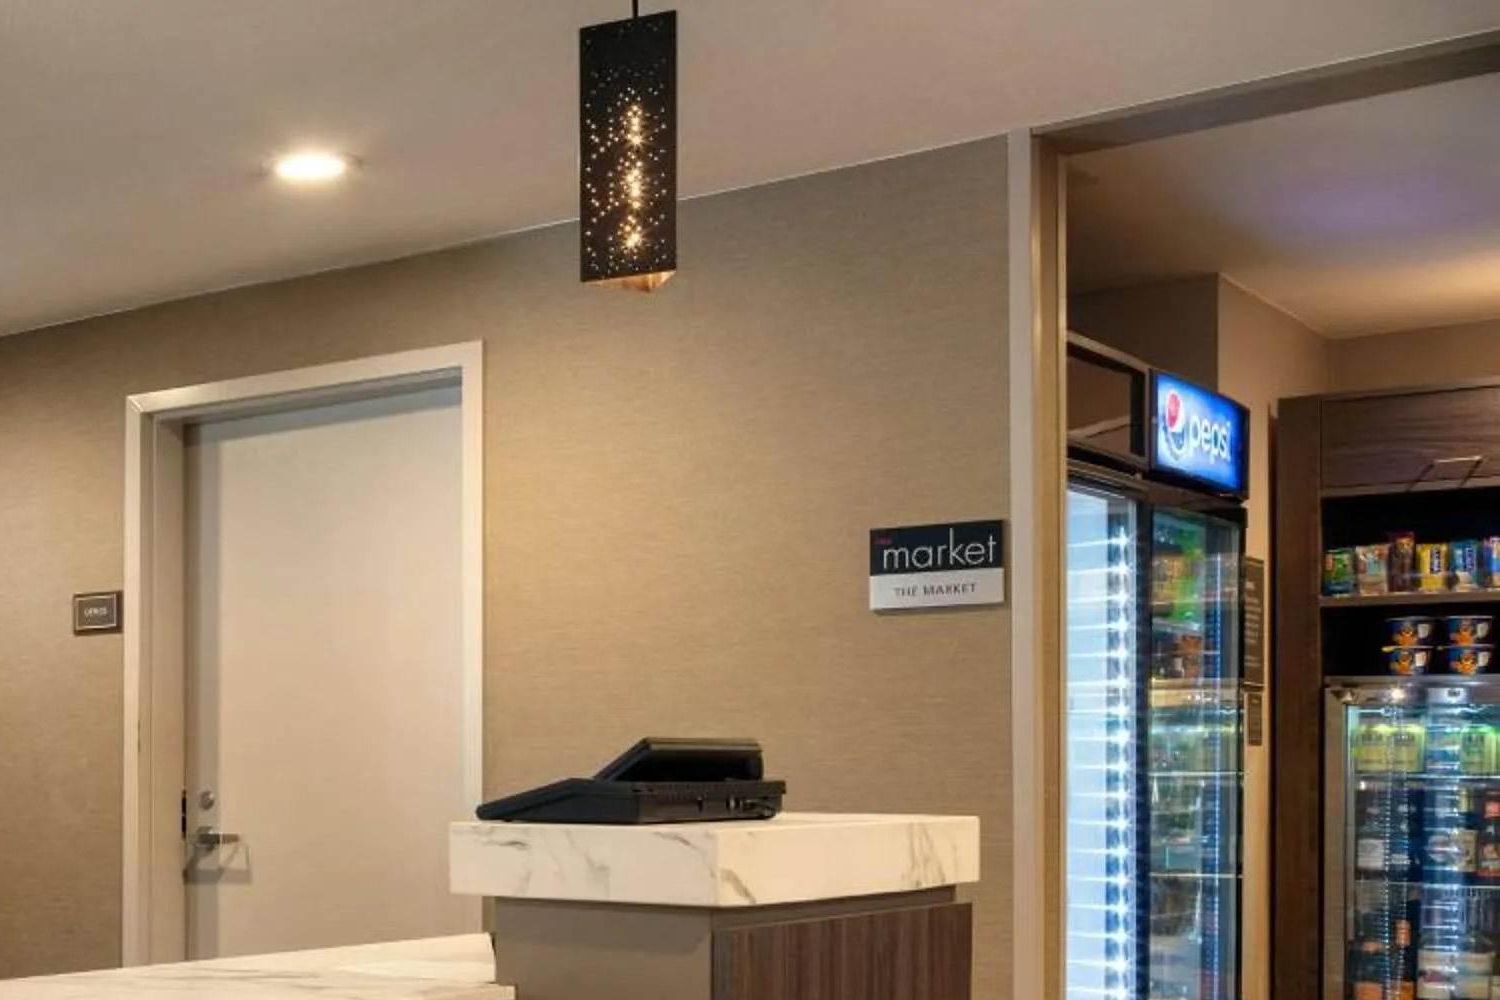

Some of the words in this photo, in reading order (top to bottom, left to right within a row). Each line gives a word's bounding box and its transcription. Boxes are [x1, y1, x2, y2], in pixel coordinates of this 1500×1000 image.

[883, 527, 997, 569] market
[894, 585, 919, 597] THE
[923, 582, 978, 596] MARKET
